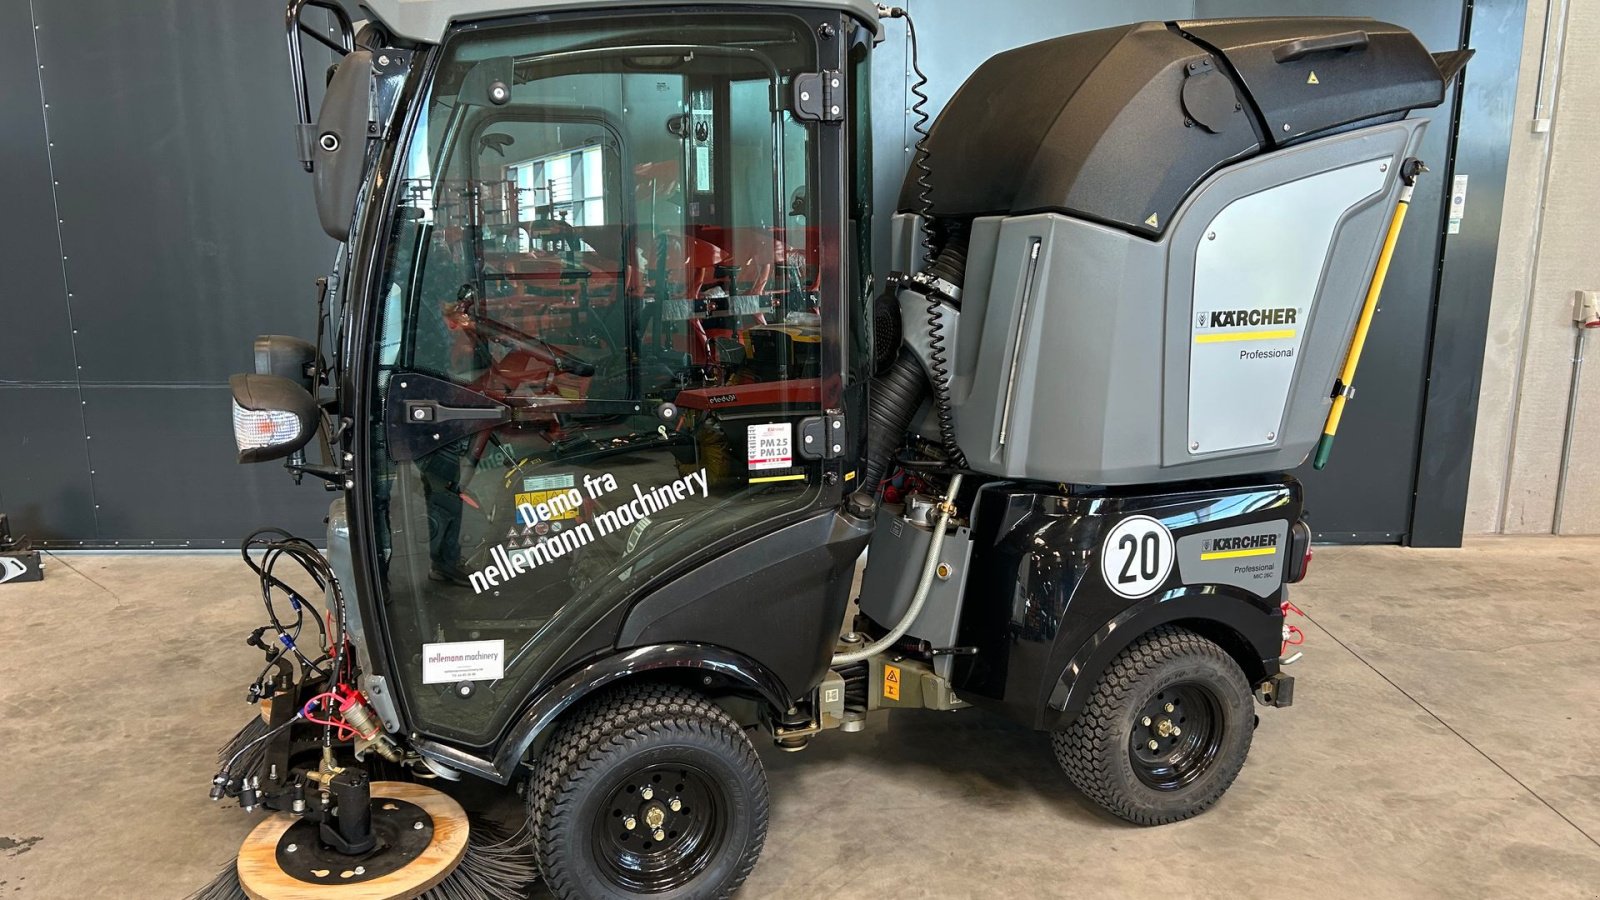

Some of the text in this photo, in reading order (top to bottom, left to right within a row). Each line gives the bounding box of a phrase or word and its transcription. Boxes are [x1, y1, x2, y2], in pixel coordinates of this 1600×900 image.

[1210, 308, 1296, 328] KÄRCHER
[1239, 348, 1294, 360] Professional
[760, 439, 775, 448] PM
[760, 447, 788, 457] PM 10
[518, 488, 584, 528] Demo
[583, 473, 618, 500] fra
[468, 467, 709, 594] nellemann machinery
[1213, 533, 1277, 551] KÄRCHER
[1118, 530, 1160, 585] 20
[1234, 562, 1274, 573] Professional
[428, 651, 498, 663] nellemann machinery
